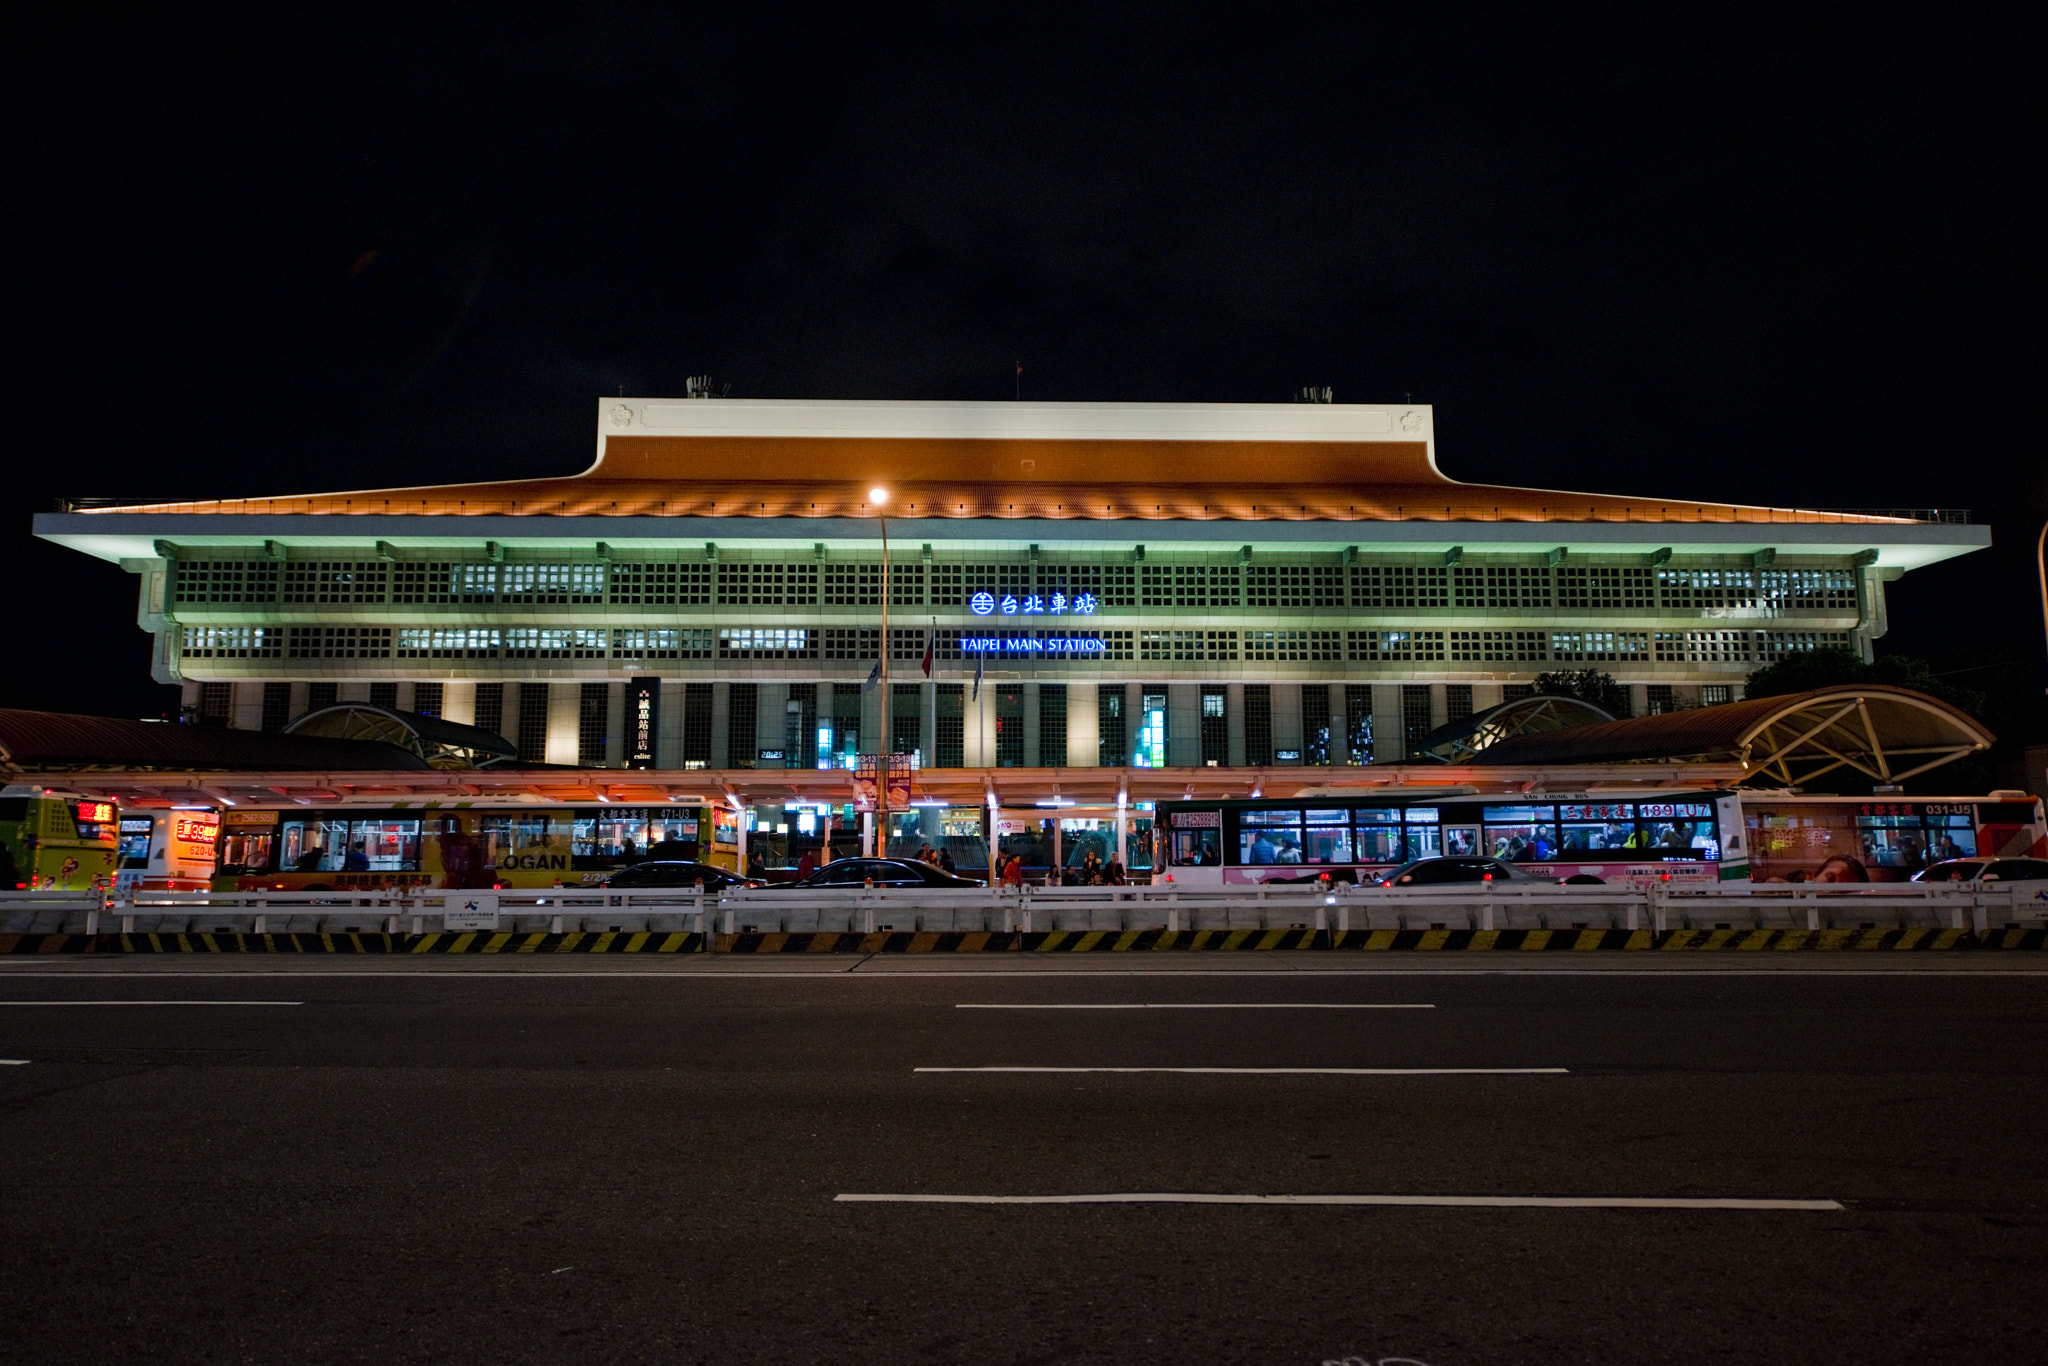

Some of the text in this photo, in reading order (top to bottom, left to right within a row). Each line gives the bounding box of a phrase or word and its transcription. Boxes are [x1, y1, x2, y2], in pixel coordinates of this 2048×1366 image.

[1001, 593, 1096, 614] 台北車站
[960, 639, 1106, 650] TAIPEI MAIN STATION
[638, 699, 650, 750] 誠品站前店
[599, 809, 649, 820] 大都會客運
[660, 809, 690, 819] 471-U3
[1566, 804, 1628, 818] 三重客運
[1642, 803, 1707, 817] 189-U7
[1926, 805, 1971, 815] 031-U5
